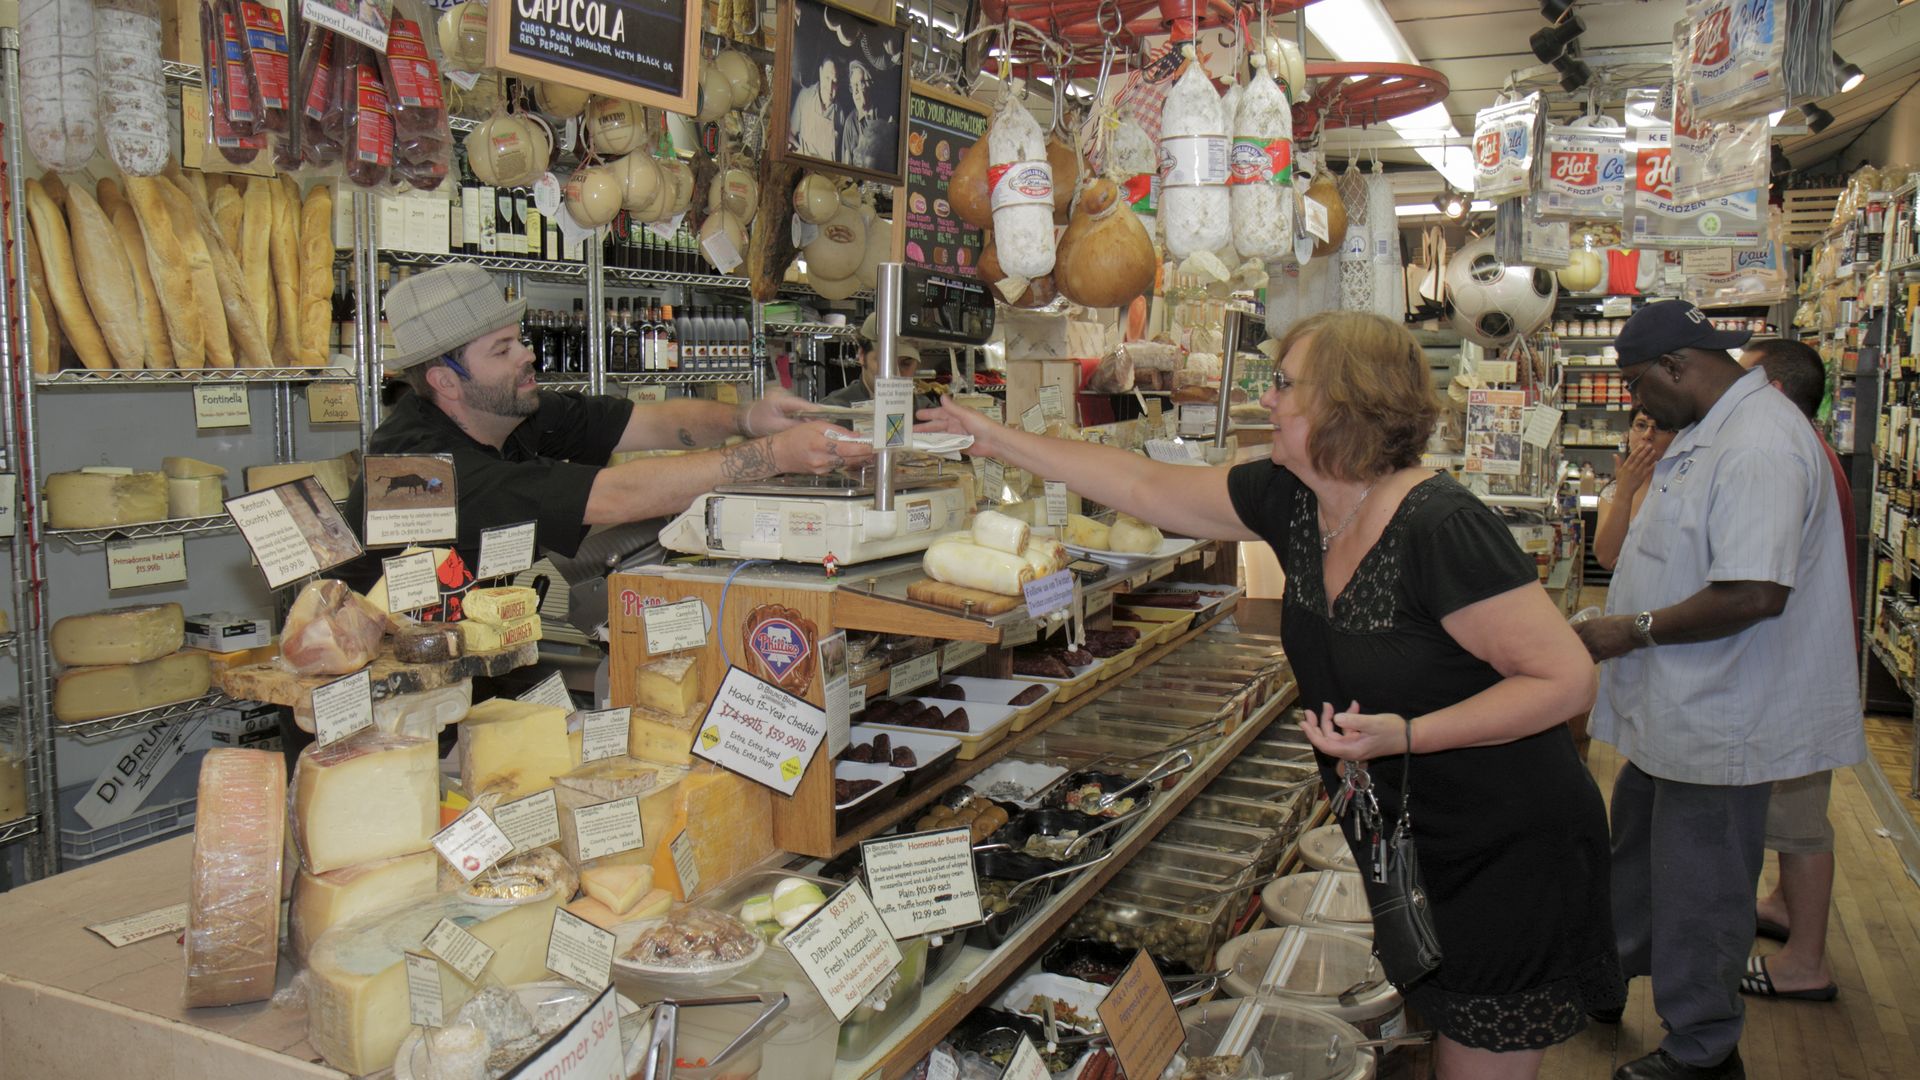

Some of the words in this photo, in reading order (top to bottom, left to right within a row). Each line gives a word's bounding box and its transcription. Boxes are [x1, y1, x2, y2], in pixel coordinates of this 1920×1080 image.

[305, 3, 340, 30] Support
[341, 18, 363, 39] Local
[365, 28, 385, 48] Foods
[517, 0, 625, 42] CAPICOLA
[520, 33, 535, 45] RED
[539, 40, 574, 57] PEPPER.
[520, 21, 546, 36] CURED
[551, 29, 572, 44] PORK
[575, 37, 612, 56] SHOULDER
[615, 51, 635, 62] WITH
[637, 54, 660, 69] BLACK
[663, 62, 673, 72] OR
[1702, 55, 1737, 79] FROZEN
[910, 97, 925, 117] FOR
[928, 104, 945, 124] YOUR
[1479, 135, 1497, 163] Hot
[1557, 156, 1591, 182] Hot
[1602, 157, 1624, 181] Co
[1645, 155, 1673, 193] Ho
[1567, 185, 1604, 195] FROZEN
[1658, 201, 1707, 213] FROZEN
[1721, 198, 1728, 206] 3
[202, 391, 242, 405] Fontinella
[323, 408, 349, 419] Asiago
[240, 497, 271, 513] Benton's
[240, 513, 269, 529] Country
[910, 512, 925, 522] 2009
[152, 553, 164, 561] Red
[165, 551, 180, 559] Label
[1025, 584, 1042, 598] Follow
[758, 633, 800, 657] Phillies
[764, 685, 782, 700] BRUNO
[728, 686, 755, 706] Hooks
[756, 699, 786, 721] 15-Year
[787, 715, 819, 737] Cheddar
[703, 731, 719, 743] CAUTION
[730, 730, 746, 744] Extra,
[747, 739, 763, 752] Extra
[763, 747, 781, 760] Aged
[97, 776, 125, 804] DI
[117, 720, 169, 777] BRUN
[742, 749, 757, 762] Extra
[757, 757, 775, 770] Sharp
[908, 839, 944, 850] Homemade
[946, 834, 968, 844] Burrata
[894, 871, 912, 881] wrapped
[913, 868, 928, 876] around
[931, 865, 945, 874] pocket
[952, 860, 968, 869] whipped
[903, 861, 913, 869] fresh
[916, 884, 937, 898] $10.99
[937, 881, 951, 891] each
[829, 898, 849, 920] $8.99
[897, 900, 915, 911] Truffle
[912, 909, 932, 922] $12.99
[933, 905, 947, 917] each
[839, 911, 870, 941] Brother's
[824, 956, 845, 979] Fresh
[844, 927, 878, 961] Mozzarella
[829, 981, 845, 997] Hand
[844, 968, 859, 983] Made
[845, 989, 858, 1002] Real
[857, 974, 876, 992] Human
[591, 1006, 613, 1047] Sale
